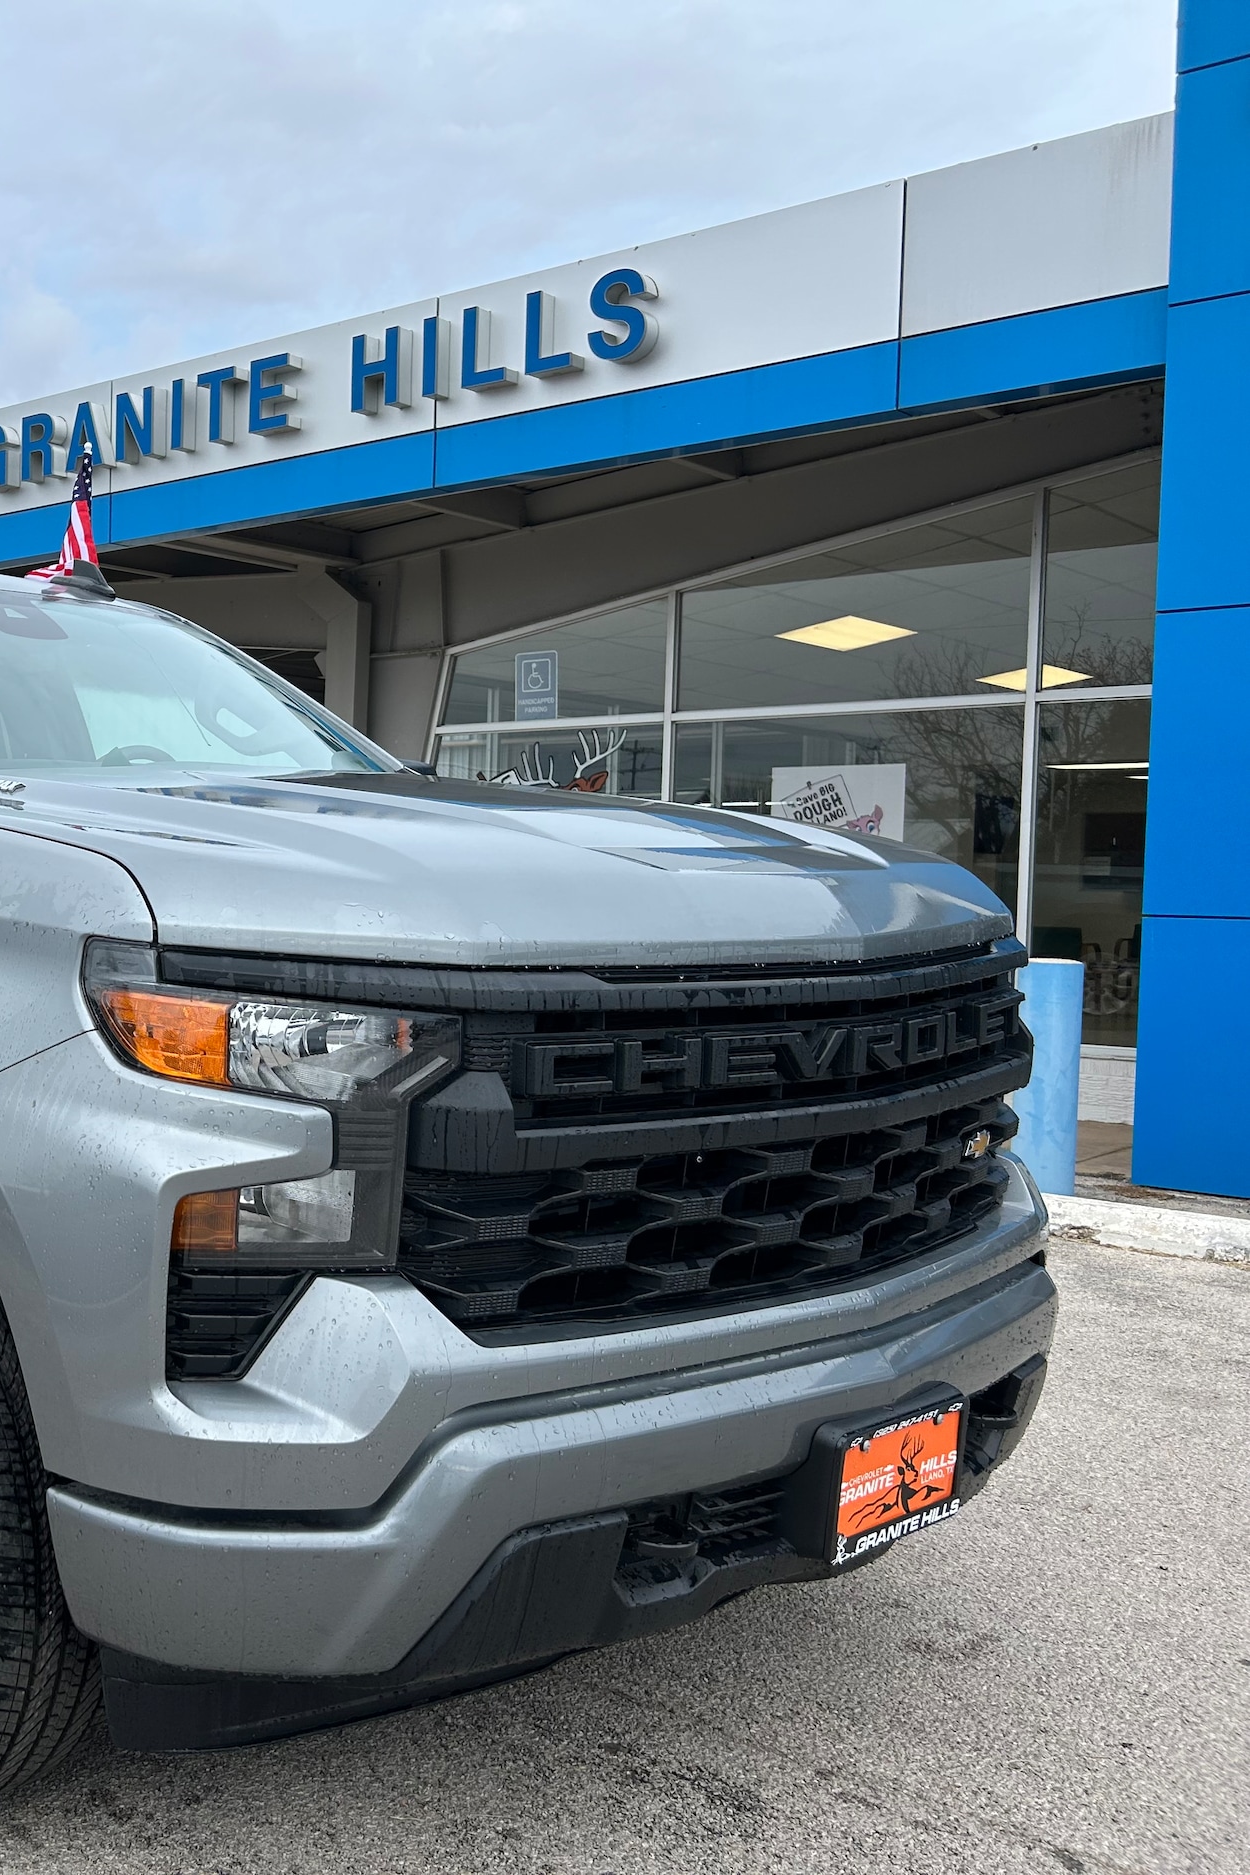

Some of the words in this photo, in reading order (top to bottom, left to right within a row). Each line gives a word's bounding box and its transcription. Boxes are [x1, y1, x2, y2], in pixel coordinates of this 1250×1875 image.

[351, 268, 658, 416] HILLS
[517, 696, 555, 706] HANDICAPPED
[524, 705, 548, 714] PARKING
[792, 792, 844, 821] DOUGH
[796, 792, 819, 807] Save
[818, 783, 836, 797] BIG
[513, 992, 1025, 1098] CHEVROLET
[839, 1472, 895, 1507] GRANITE
[919, 1449, 957, 1475] HILLS
[849, 1466, 884, 1487] CHEVROLET
[855, 1513, 921, 1554] GRANITE
[920, 1498, 960, 1527] HILLS
